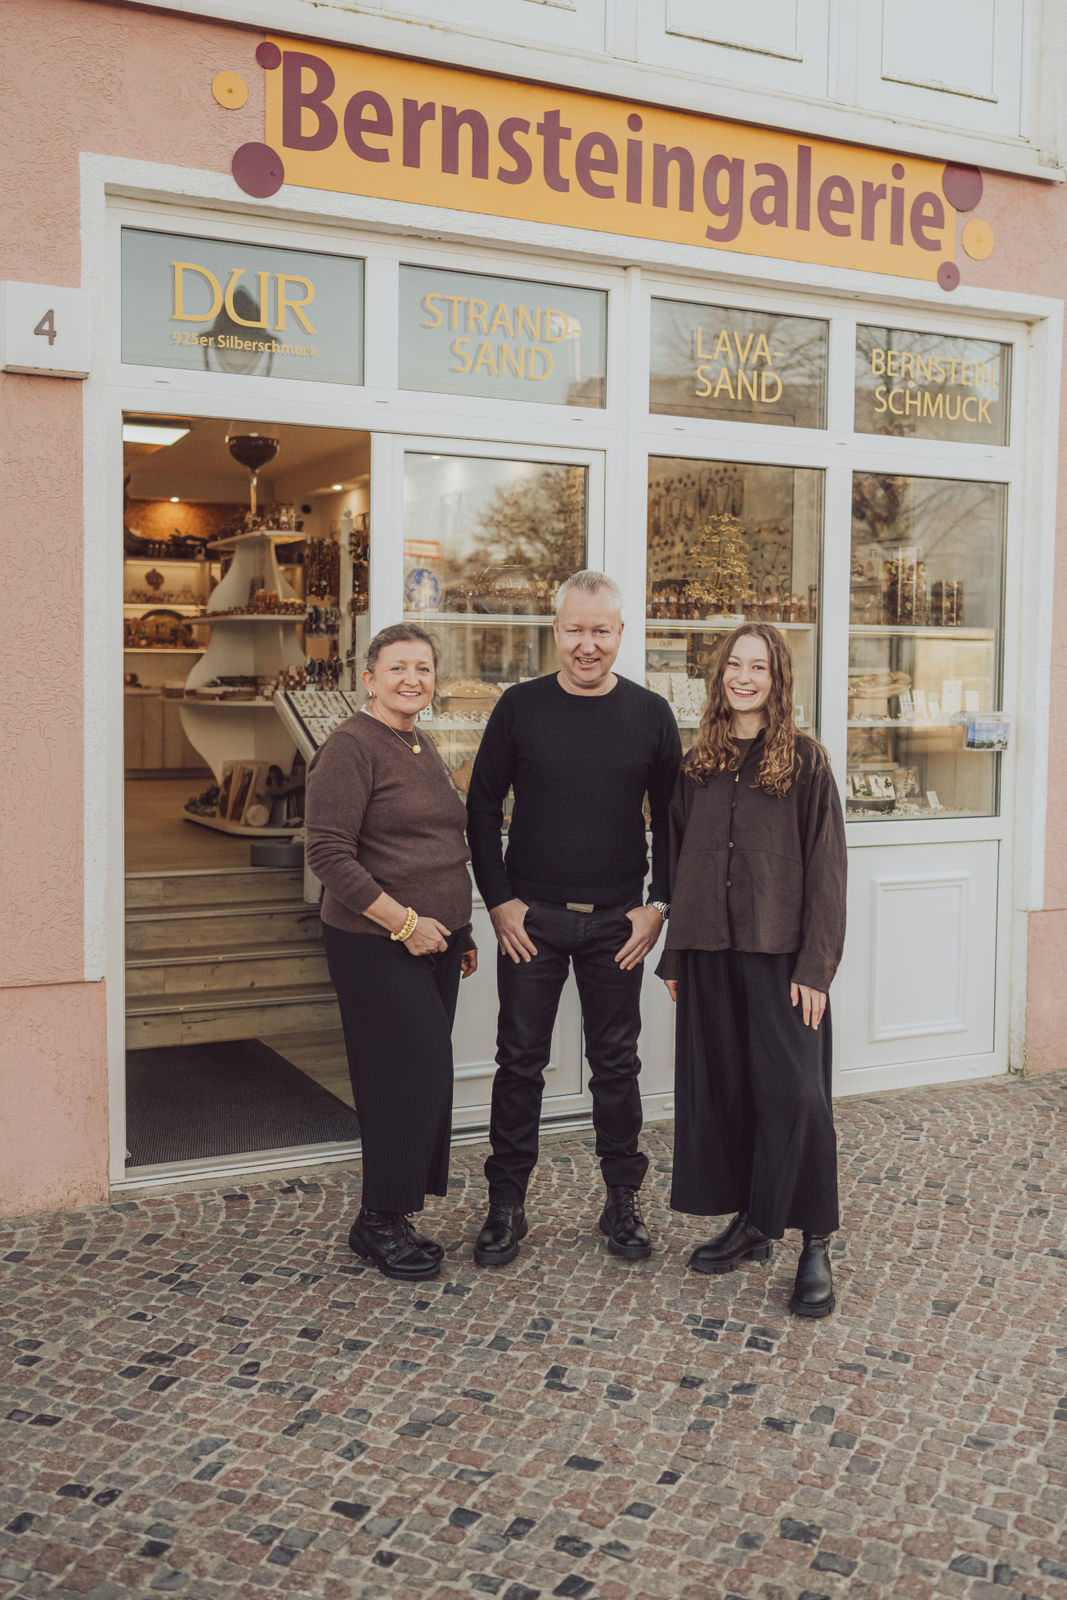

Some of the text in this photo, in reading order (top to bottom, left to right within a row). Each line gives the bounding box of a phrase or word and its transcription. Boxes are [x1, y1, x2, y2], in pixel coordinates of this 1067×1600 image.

[282, 51, 945, 252] Bernsteingalerie
[171, 261, 318, 335] DUR
[423, 293, 583, 342] STRAND-
[34, 309, 57, 346] 4
[172, 330, 319, 357] 925er Silberschmuck
[696, 327, 784, 366] LAVA-
[453, 337, 554, 380] SAND
[695, 365, 784, 403] SAND
[873, 386, 993, 424] SCHMUCK
